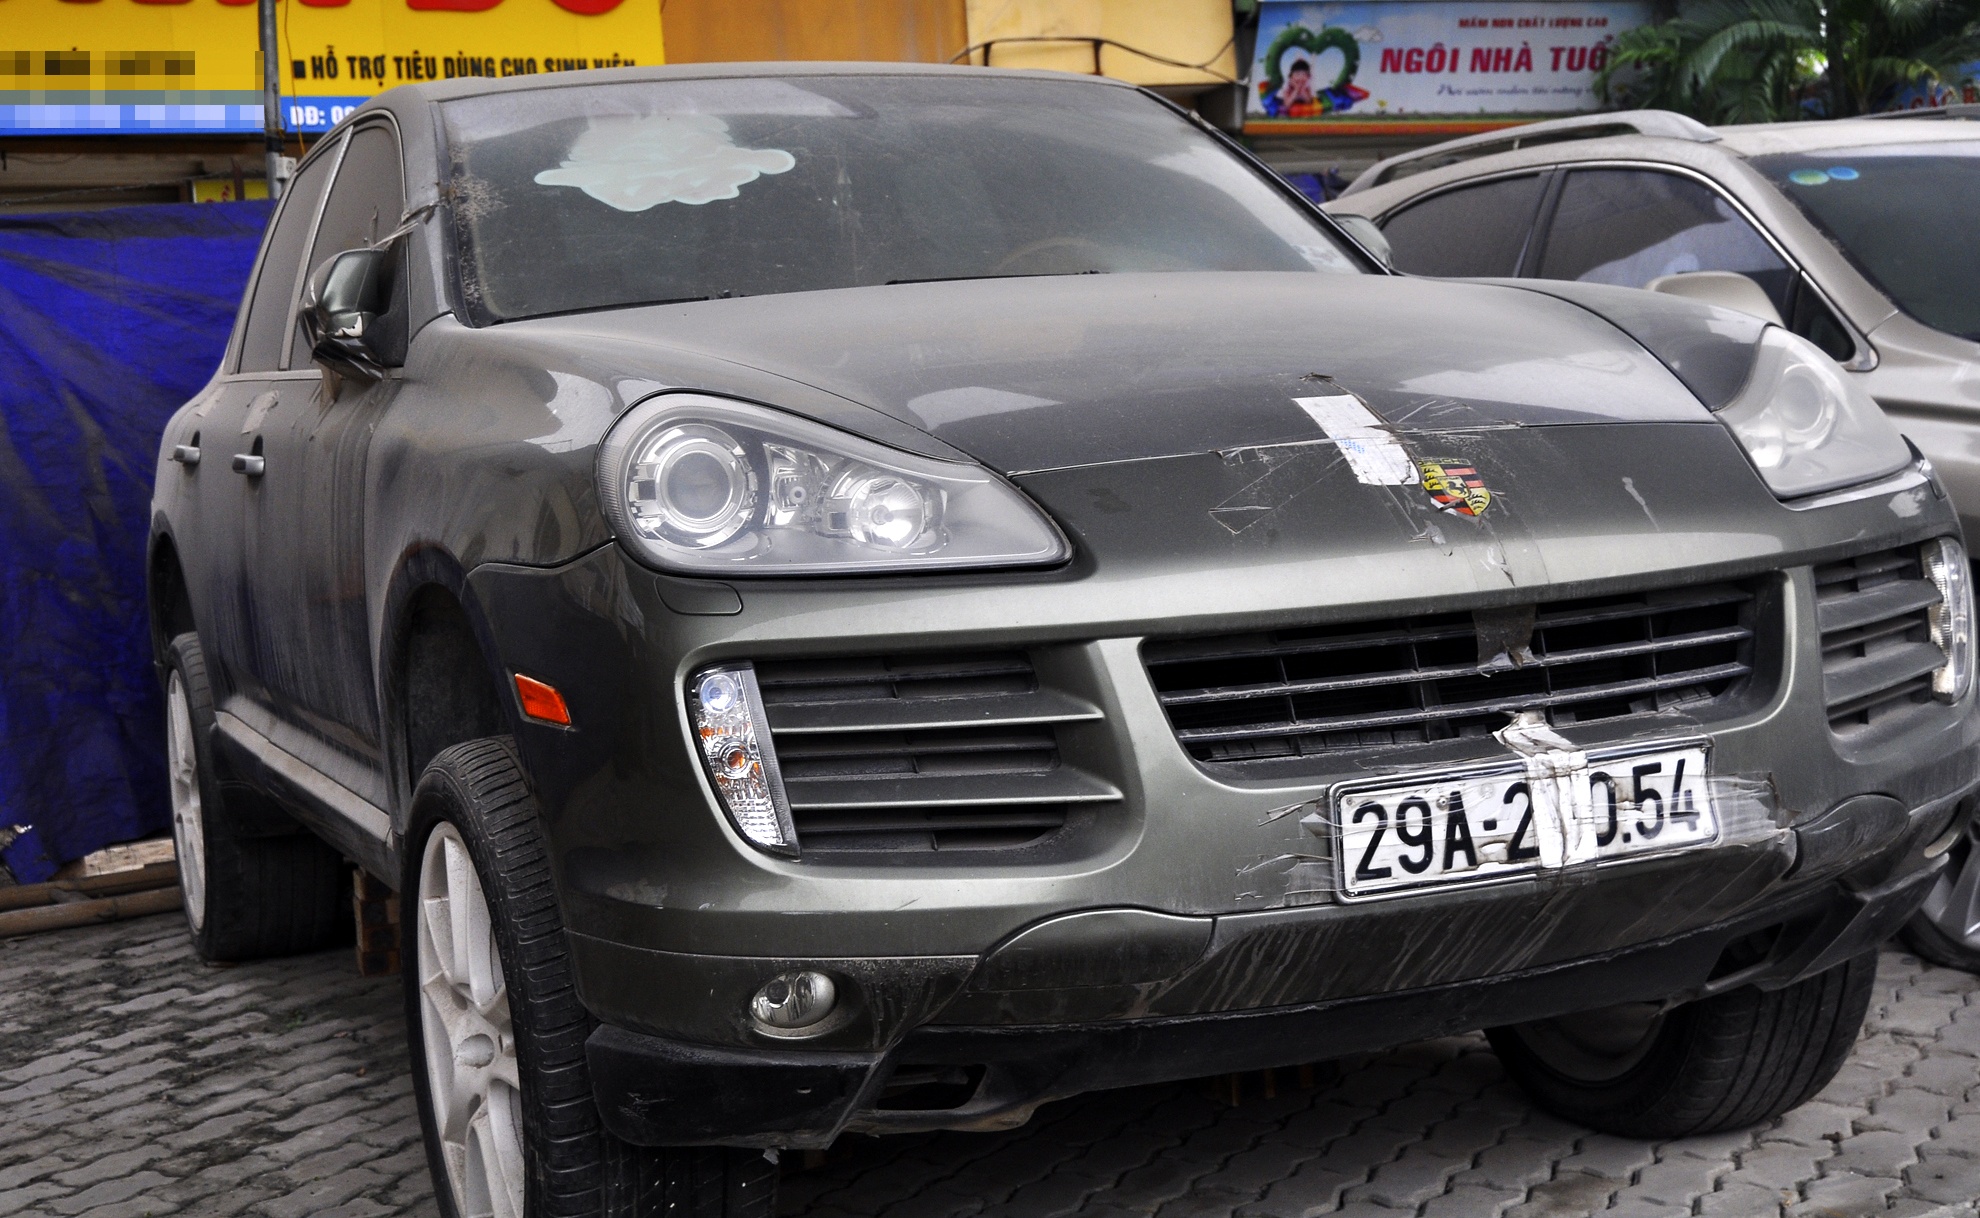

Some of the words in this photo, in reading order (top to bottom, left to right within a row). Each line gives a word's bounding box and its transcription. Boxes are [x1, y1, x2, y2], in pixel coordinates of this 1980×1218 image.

[311, 44, 338, 79] HỖ
[346, 54, 386, 87] TRỢ
[393, 49, 437, 79] TIÊU
[443, 50, 496, 79] DÙNG
[500, 57, 538, 77] CHO
[1380, 42, 1460, 74] NGÔI
[1469, 41, 1533, 73] NHÀ
[1549, 34, 1616, 73] TUỔ
[1352, 758, 1700, 880] 29A-20.54
